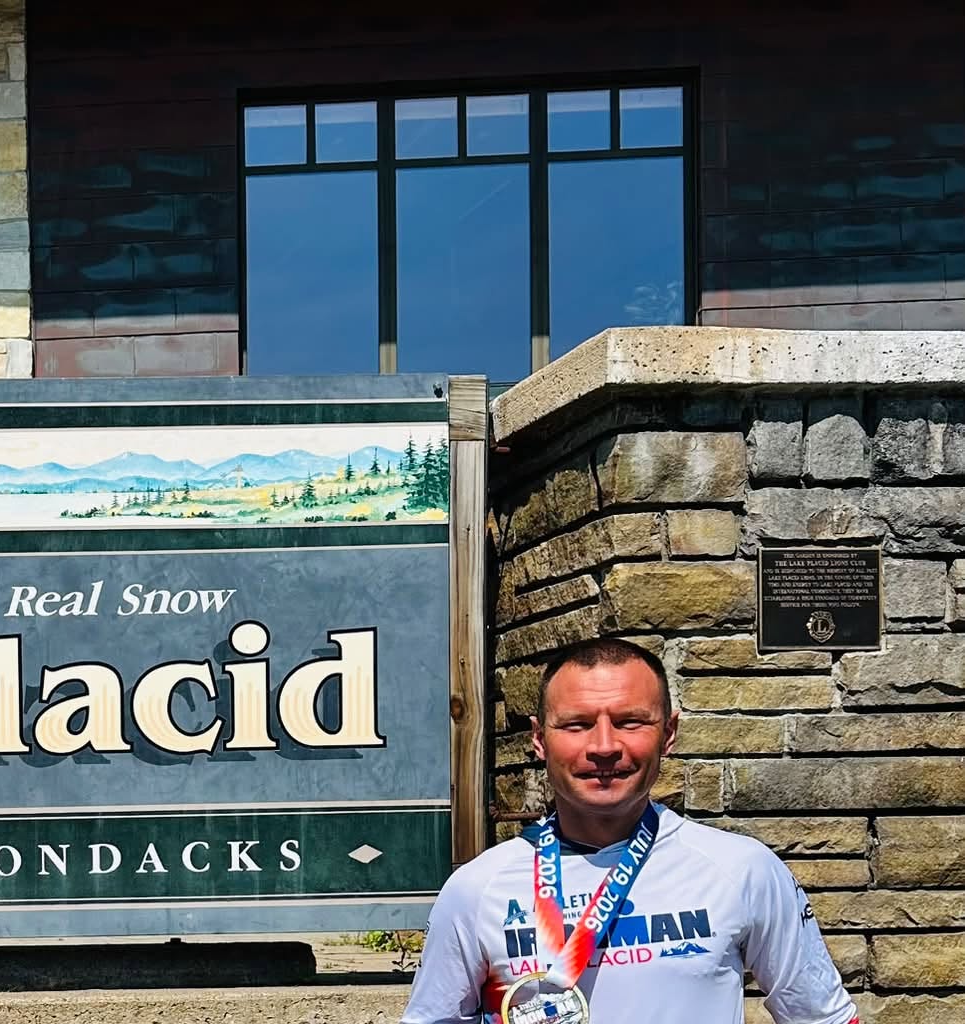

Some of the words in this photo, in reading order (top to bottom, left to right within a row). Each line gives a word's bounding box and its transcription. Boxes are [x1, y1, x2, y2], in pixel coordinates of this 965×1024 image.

[3, 580, 104, 617] Real
[117, 583, 237, 617] Snow
[817, 620, 827, 633] L
[628, 822, 653, 865] JULY
[538, 853, 557, 899] 2026
[607, 863, 633, 886] 19,
[584, 886, 619, 933] 2026
[503, 902, 712, 959] IRMAN
[586, 948, 652, 968] LACID
